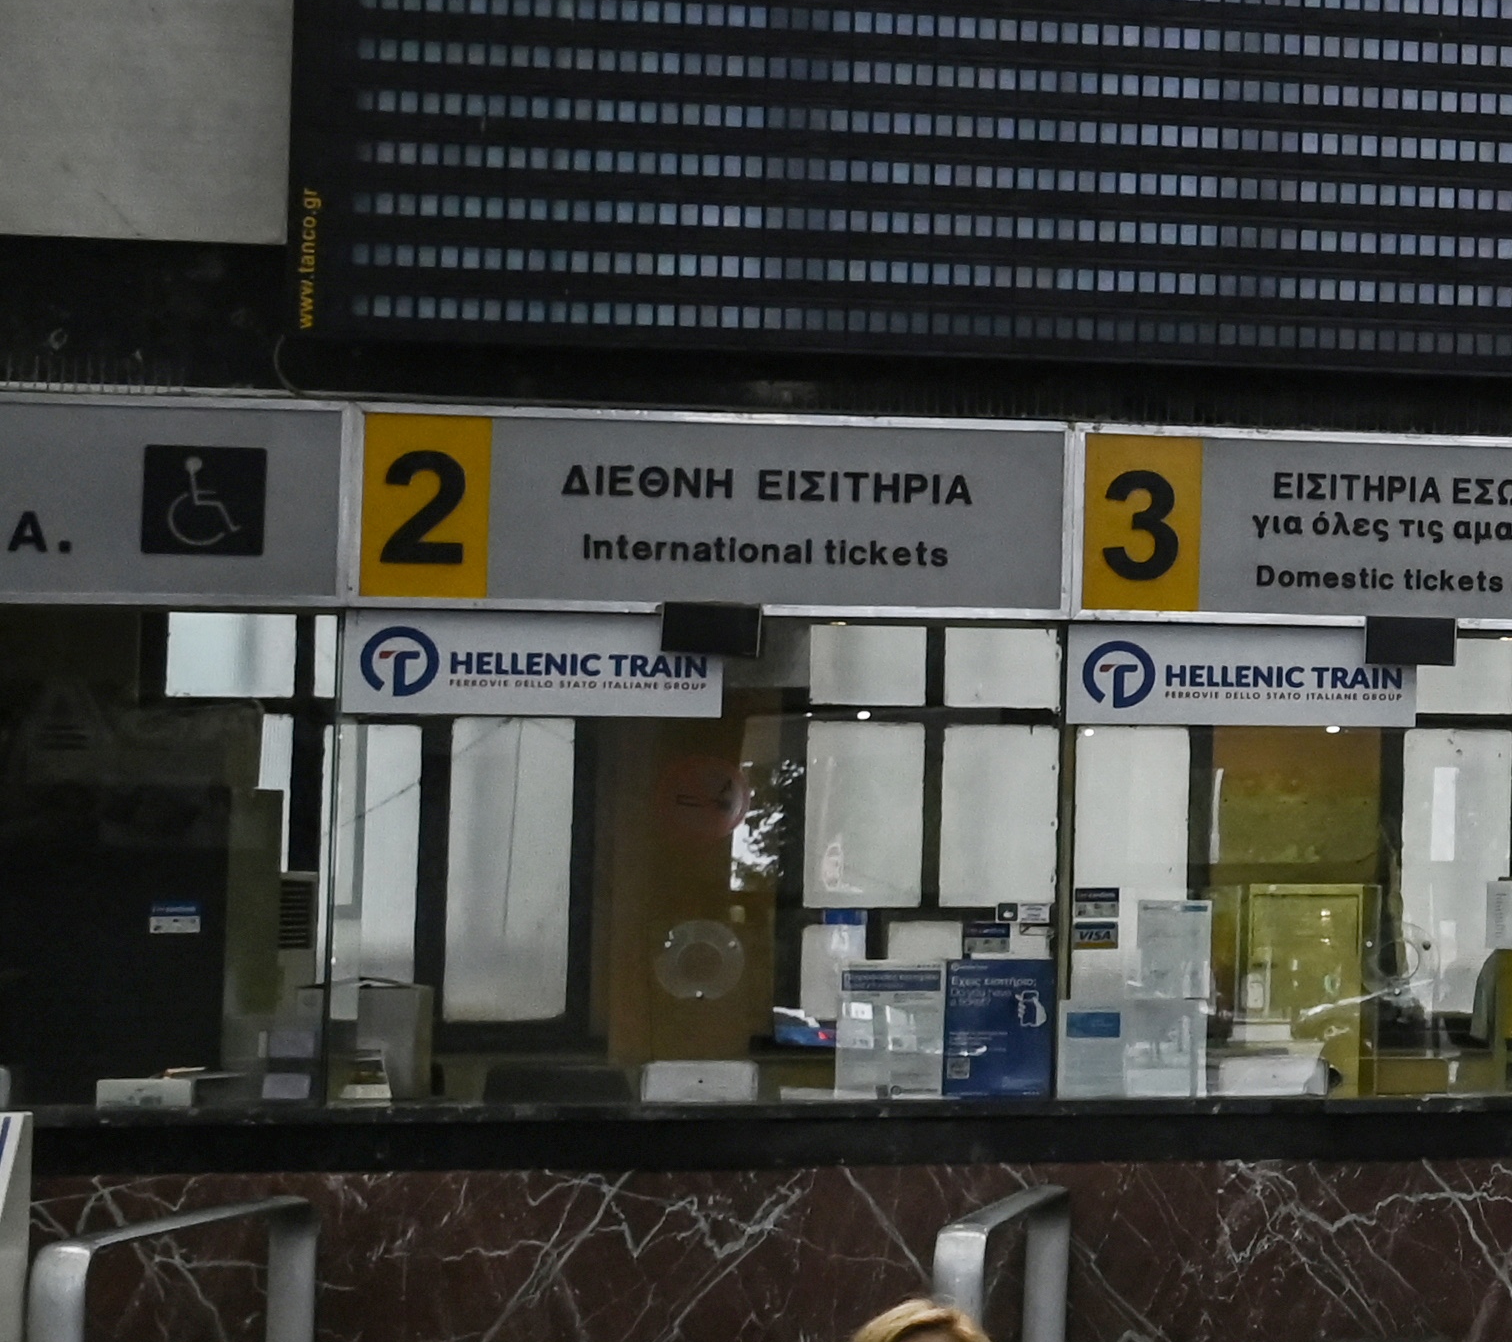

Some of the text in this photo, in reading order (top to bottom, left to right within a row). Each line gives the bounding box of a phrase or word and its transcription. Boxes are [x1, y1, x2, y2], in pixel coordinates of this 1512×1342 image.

[298, 188, 322, 329] www.tanco.gr
[561, 464, 973, 506] ΔΙΕΘΝΗ ΕΙΣΙΤΗΡΙΑ
[1273, 471, 1441, 504] ΕΙΣΙΤΗΡΙΑ
[379, 449, 466, 566] 2
[1102, 469, 1179, 582] 3
[1251, 514, 1303, 539] για
[1312, 510, 1389, 543] όλες
[1398, 518, 1444, 544] τις
[583, 533, 948, 568] International tickets
[1256, 564, 1394, 590] Domestic
[1403, 568, 1504, 593] tickets
[450, 650, 711, 679] HELLENIC TRAIN
[1165, 662, 1406, 690] HELLENIC TRAIN
[1080, 931, 1111, 940] VISA
